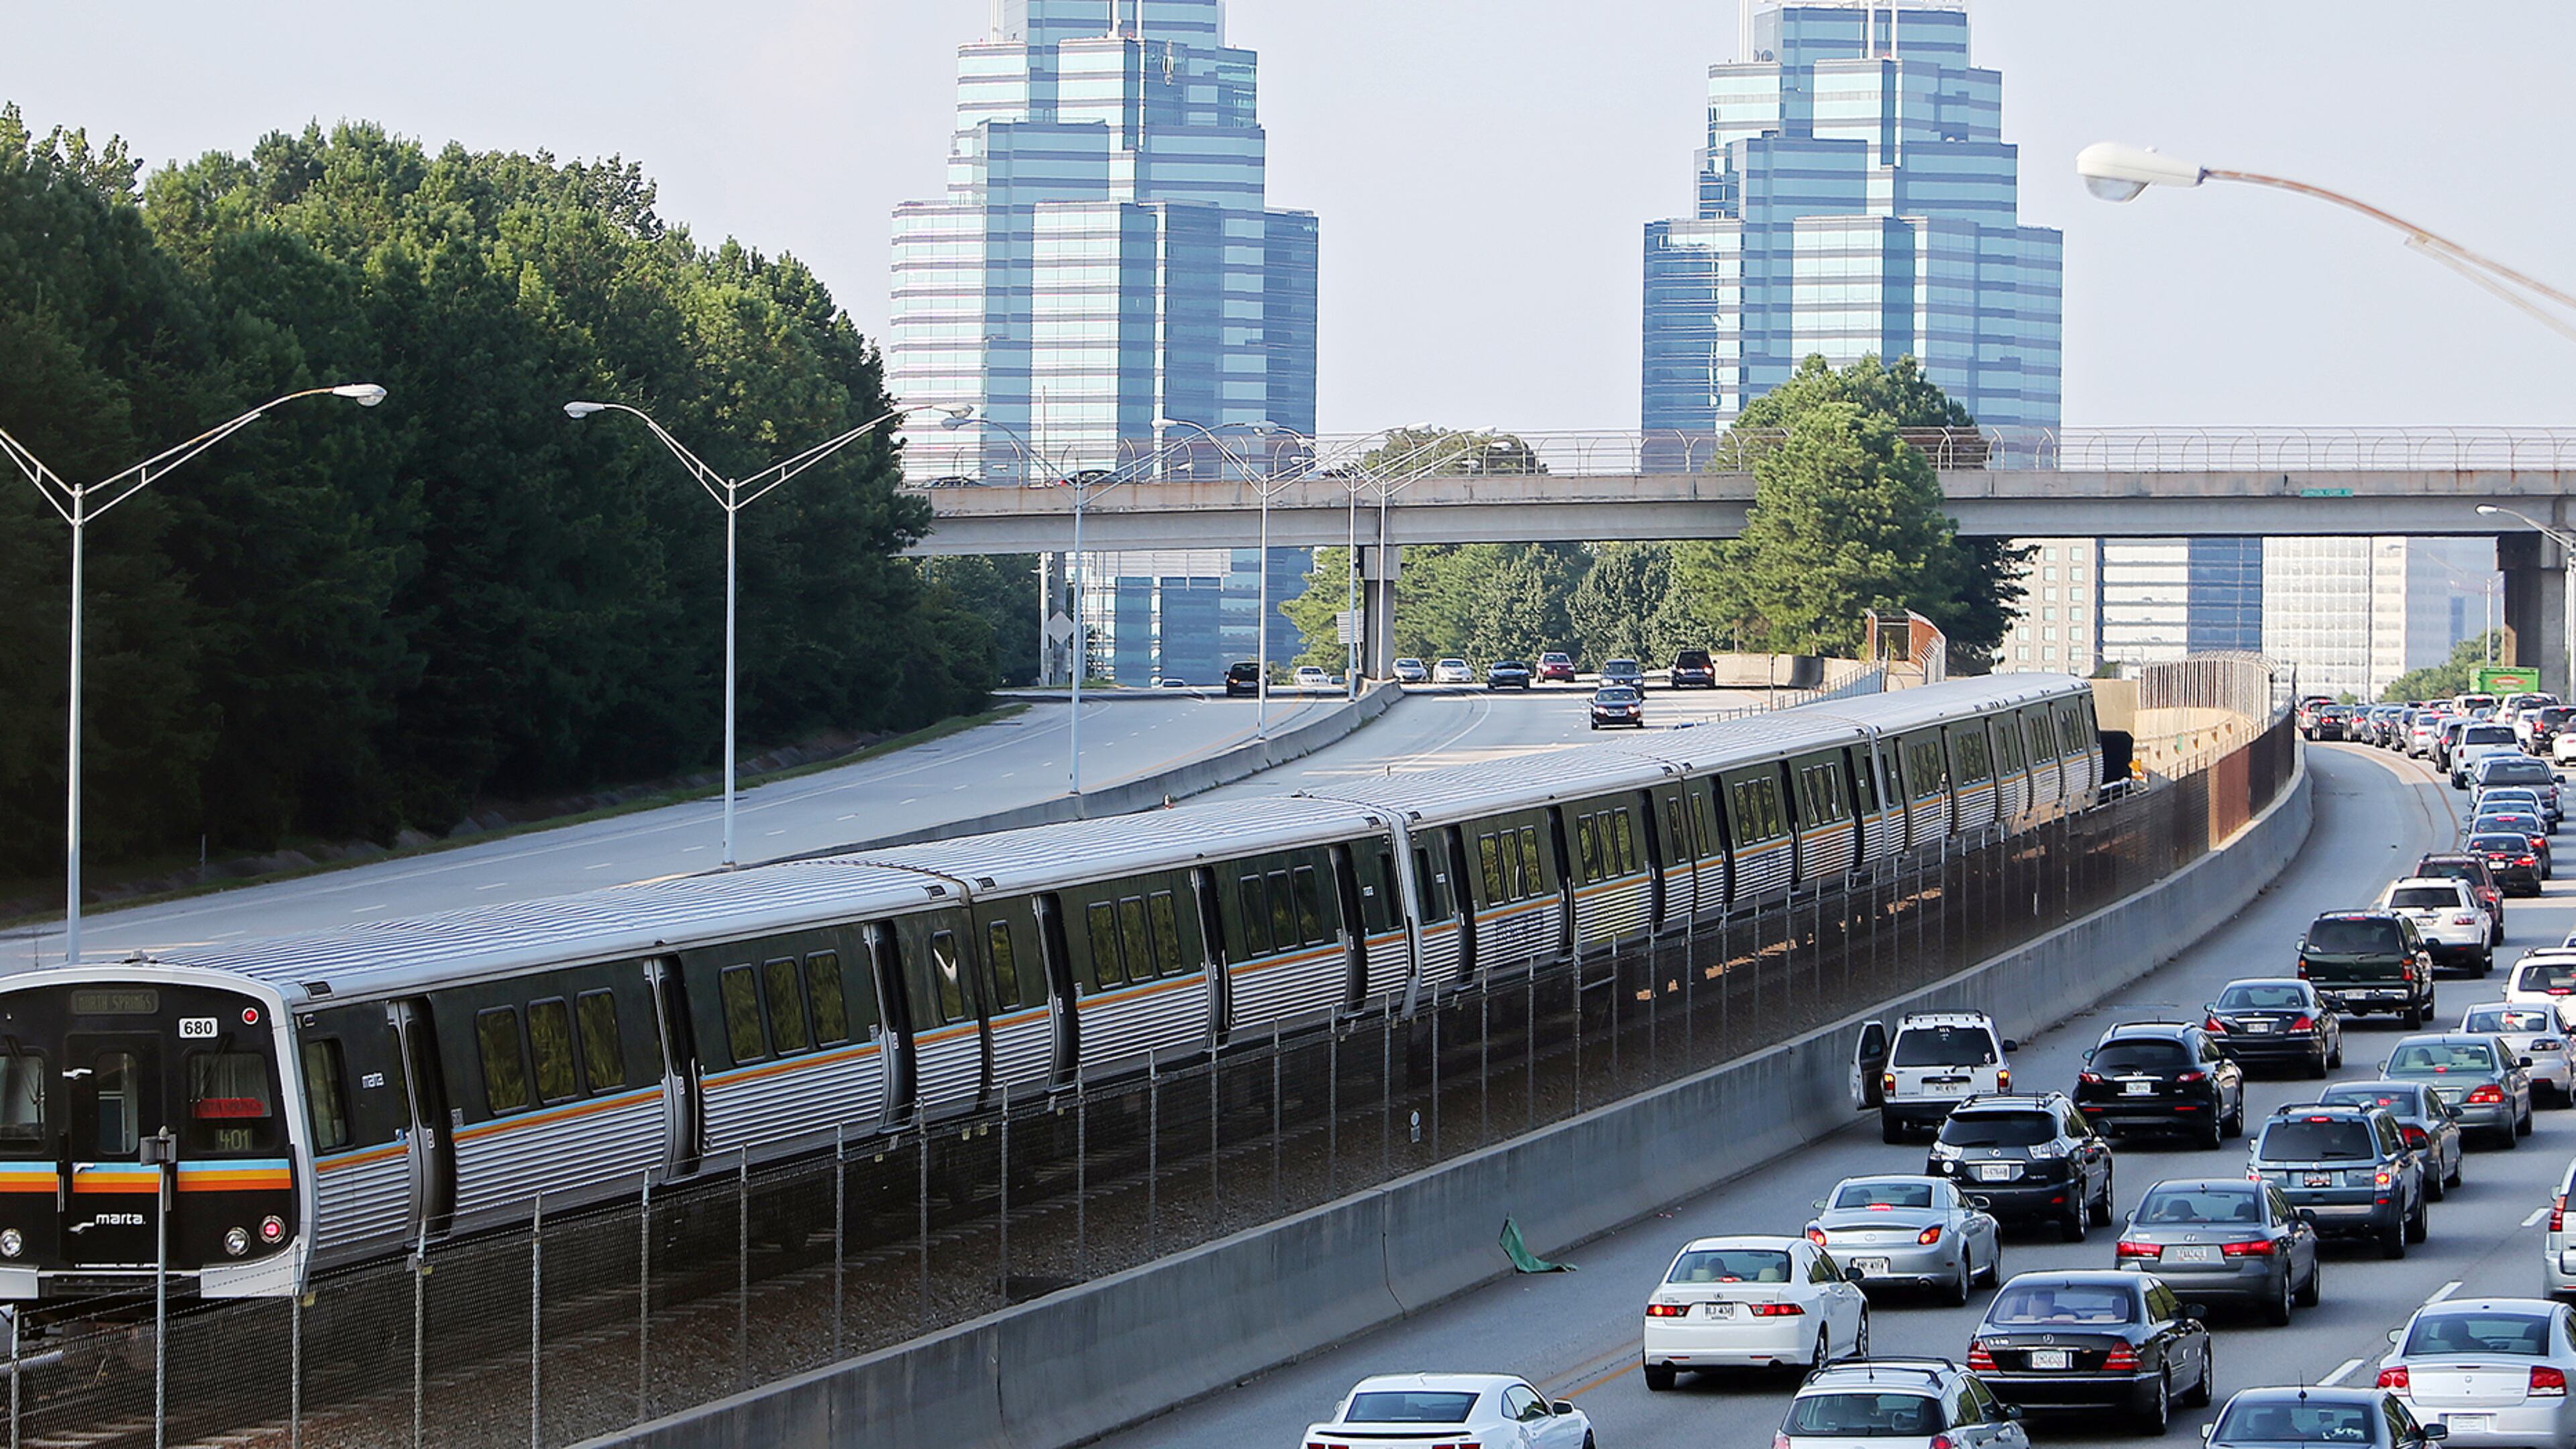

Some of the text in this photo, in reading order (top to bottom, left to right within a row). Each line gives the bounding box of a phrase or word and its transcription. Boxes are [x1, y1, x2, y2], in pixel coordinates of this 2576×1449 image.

[78, 994, 152, 1011] NORTH SPRINGS
[184, 1020, 213, 1035] 680
[219, 1128, 249, 1150] 401
